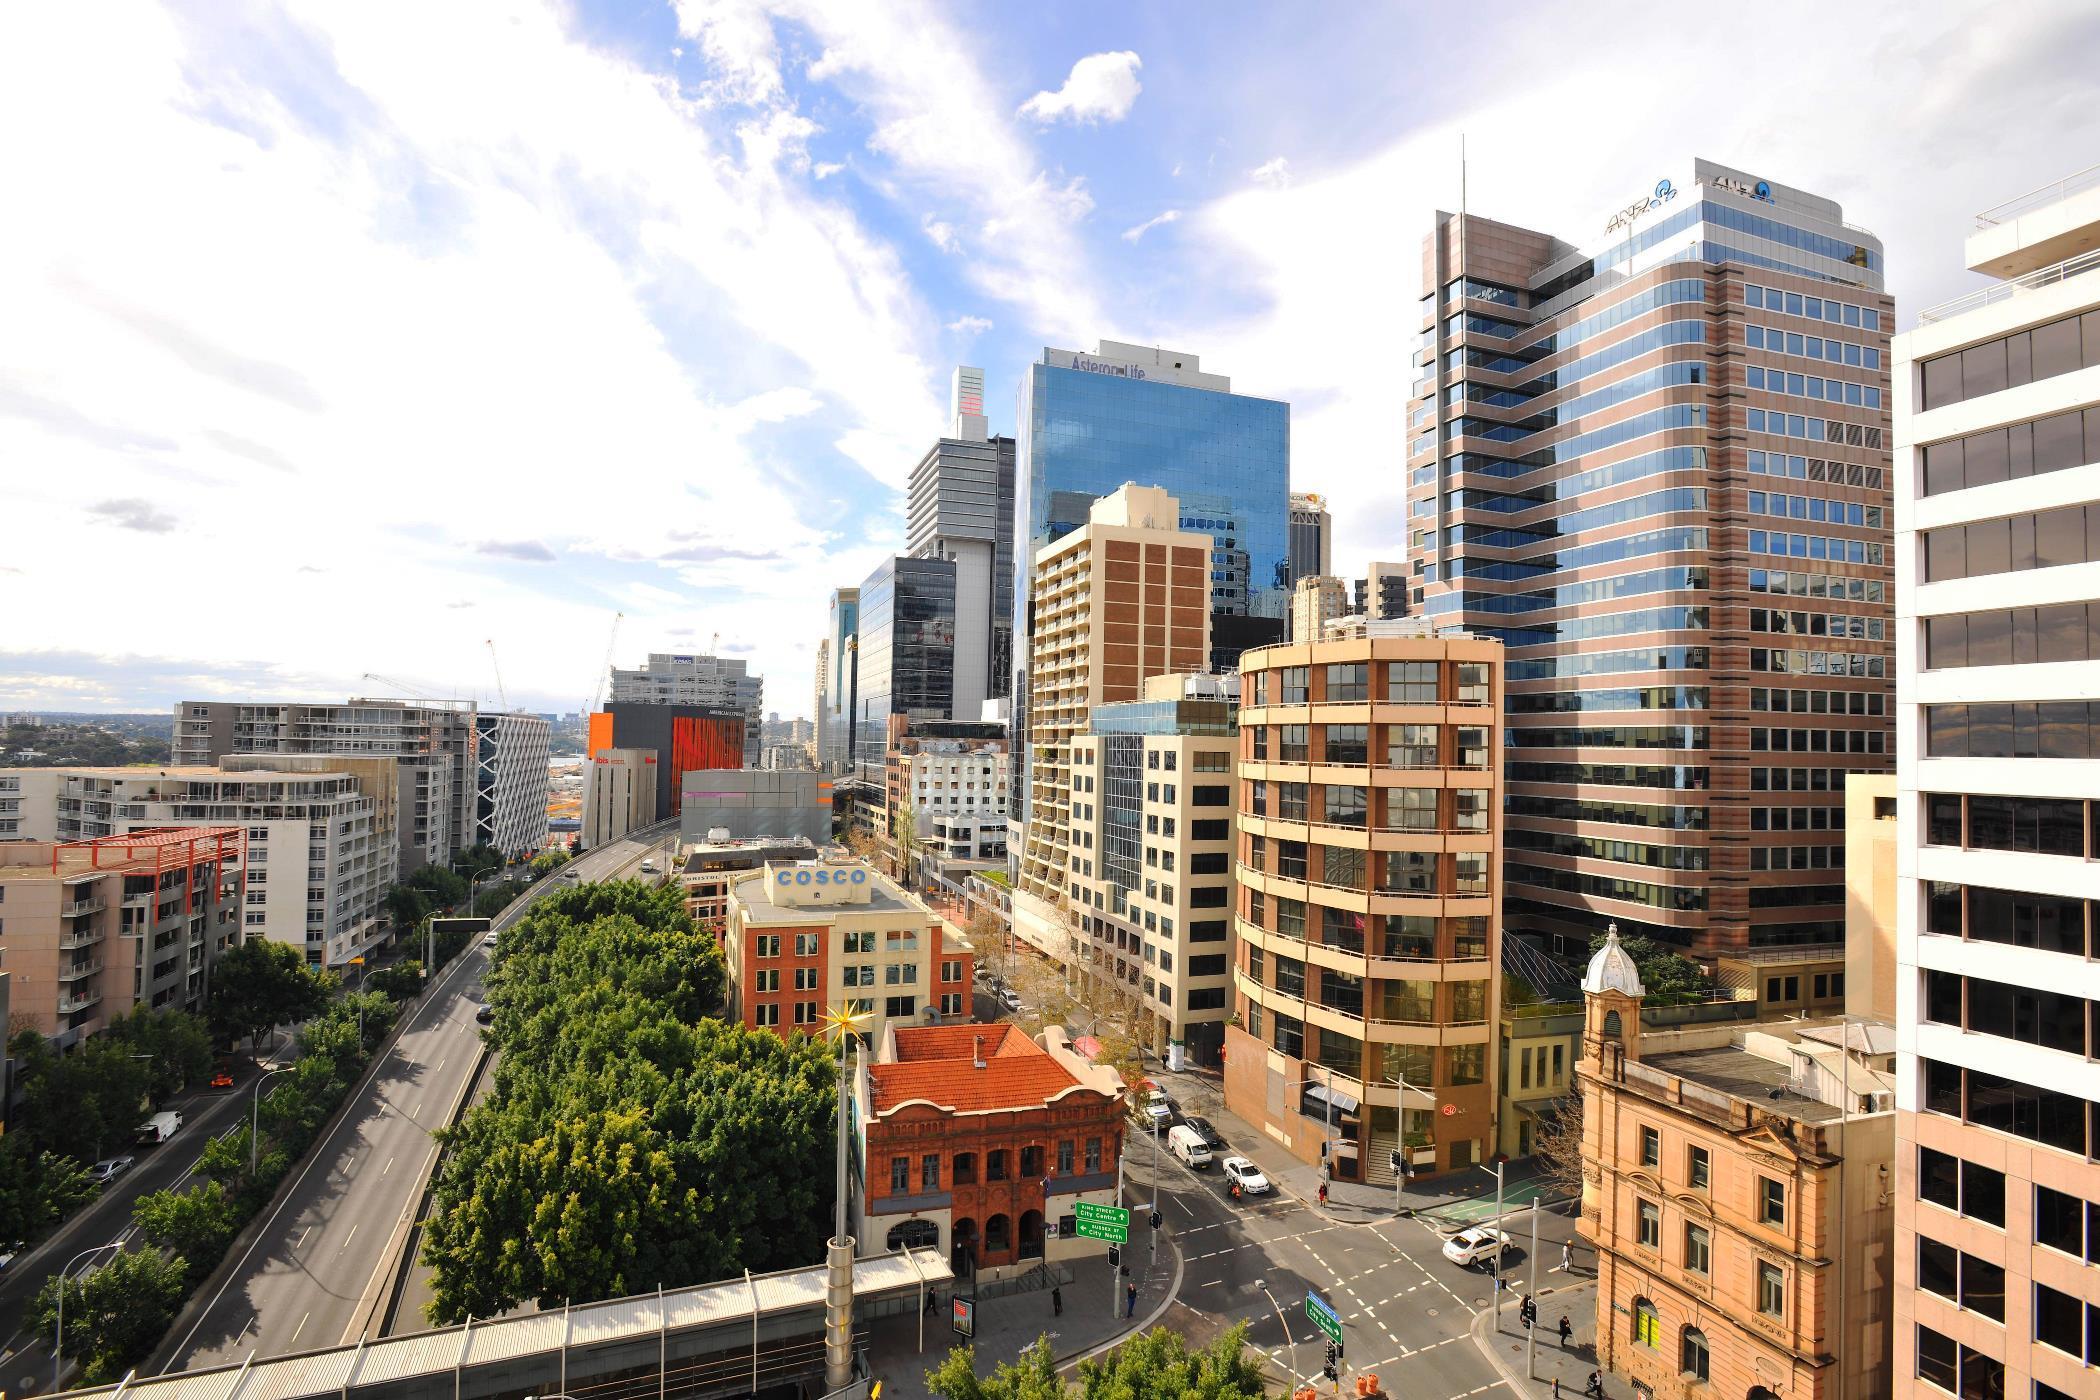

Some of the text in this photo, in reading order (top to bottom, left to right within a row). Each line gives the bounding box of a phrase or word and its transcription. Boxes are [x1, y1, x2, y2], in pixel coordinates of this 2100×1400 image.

[1604, 196, 1650, 235] ANZ
[1072, 356, 1145, 379] Asteron Life
[777, 869, 866, 886] COSCO
